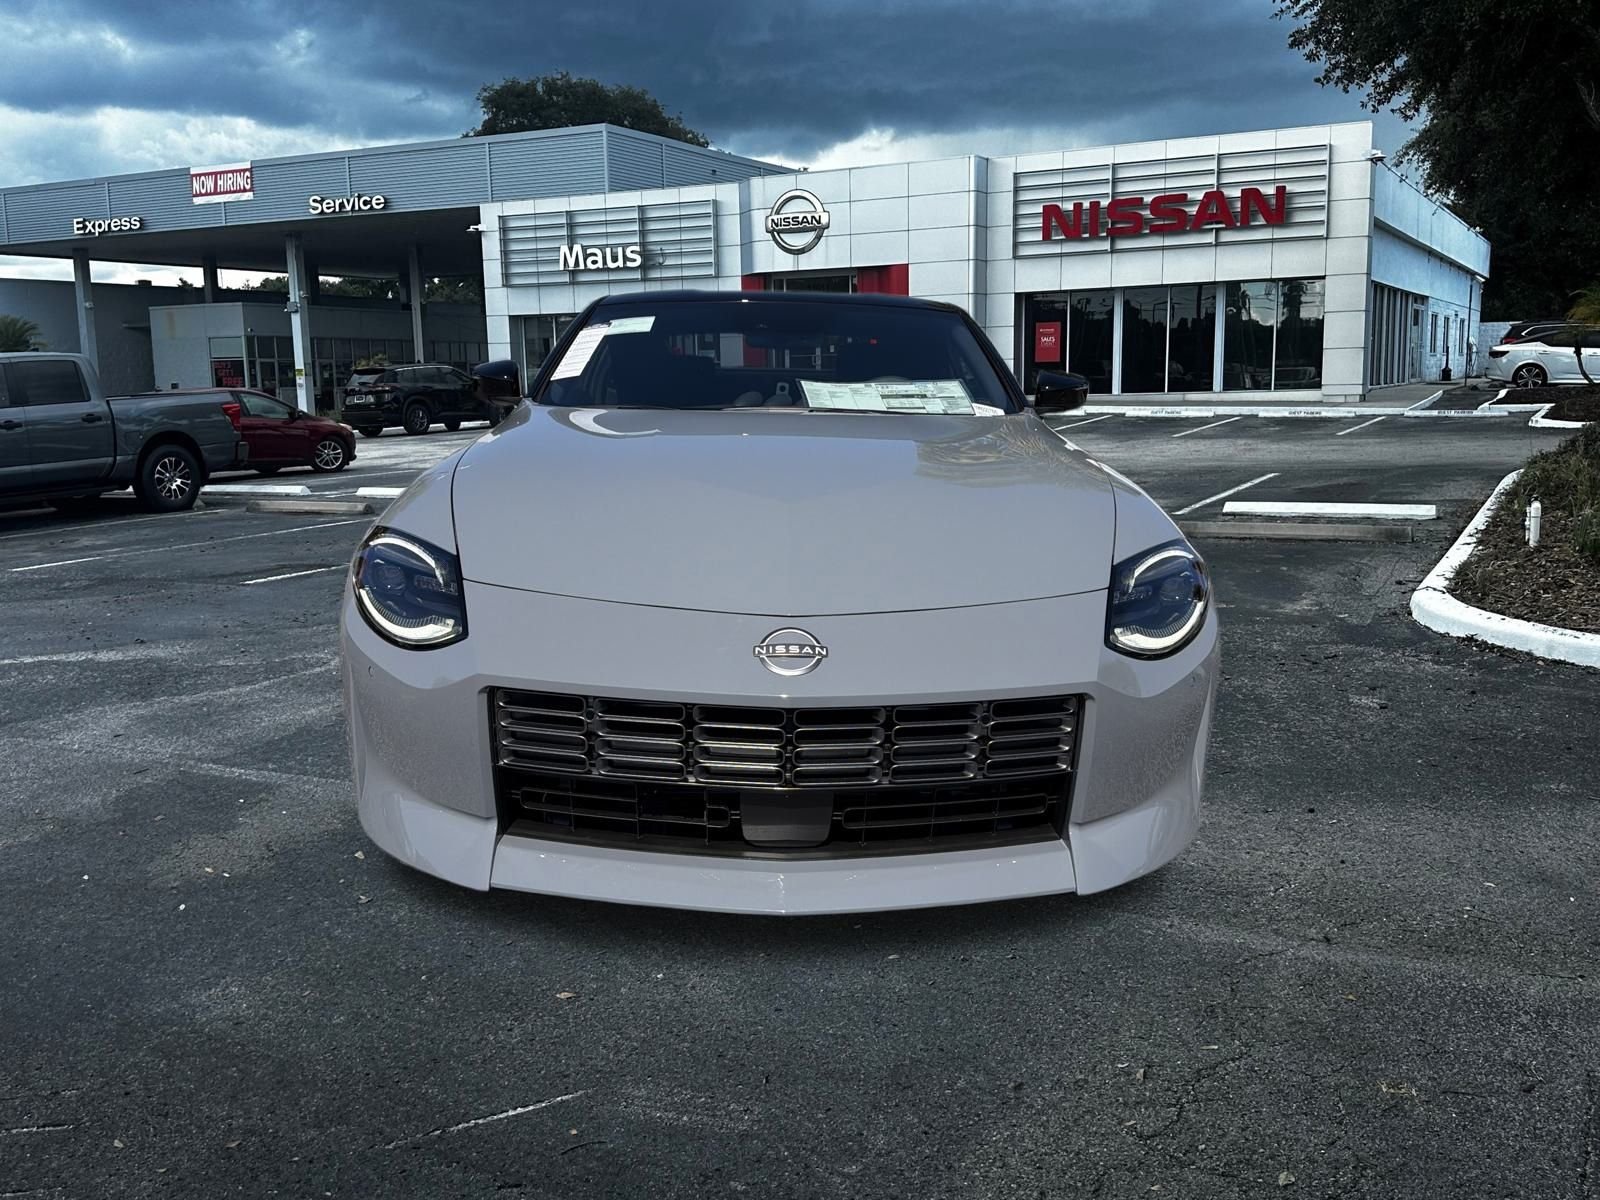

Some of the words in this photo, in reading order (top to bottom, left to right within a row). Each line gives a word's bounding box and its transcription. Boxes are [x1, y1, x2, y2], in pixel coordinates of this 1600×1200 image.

[192, 174, 216, 195] NOW
[217, 171, 251, 193] HIRING
[309, 193, 385, 214] Service
[1042, 185, 1287, 241] NISSAN
[73, 216, 141, 237] Express
[770, 215, 822, 228] NISSAN
[559, 243, 642, 271] Maus
[755, 645, 827, 655] NISSAN
